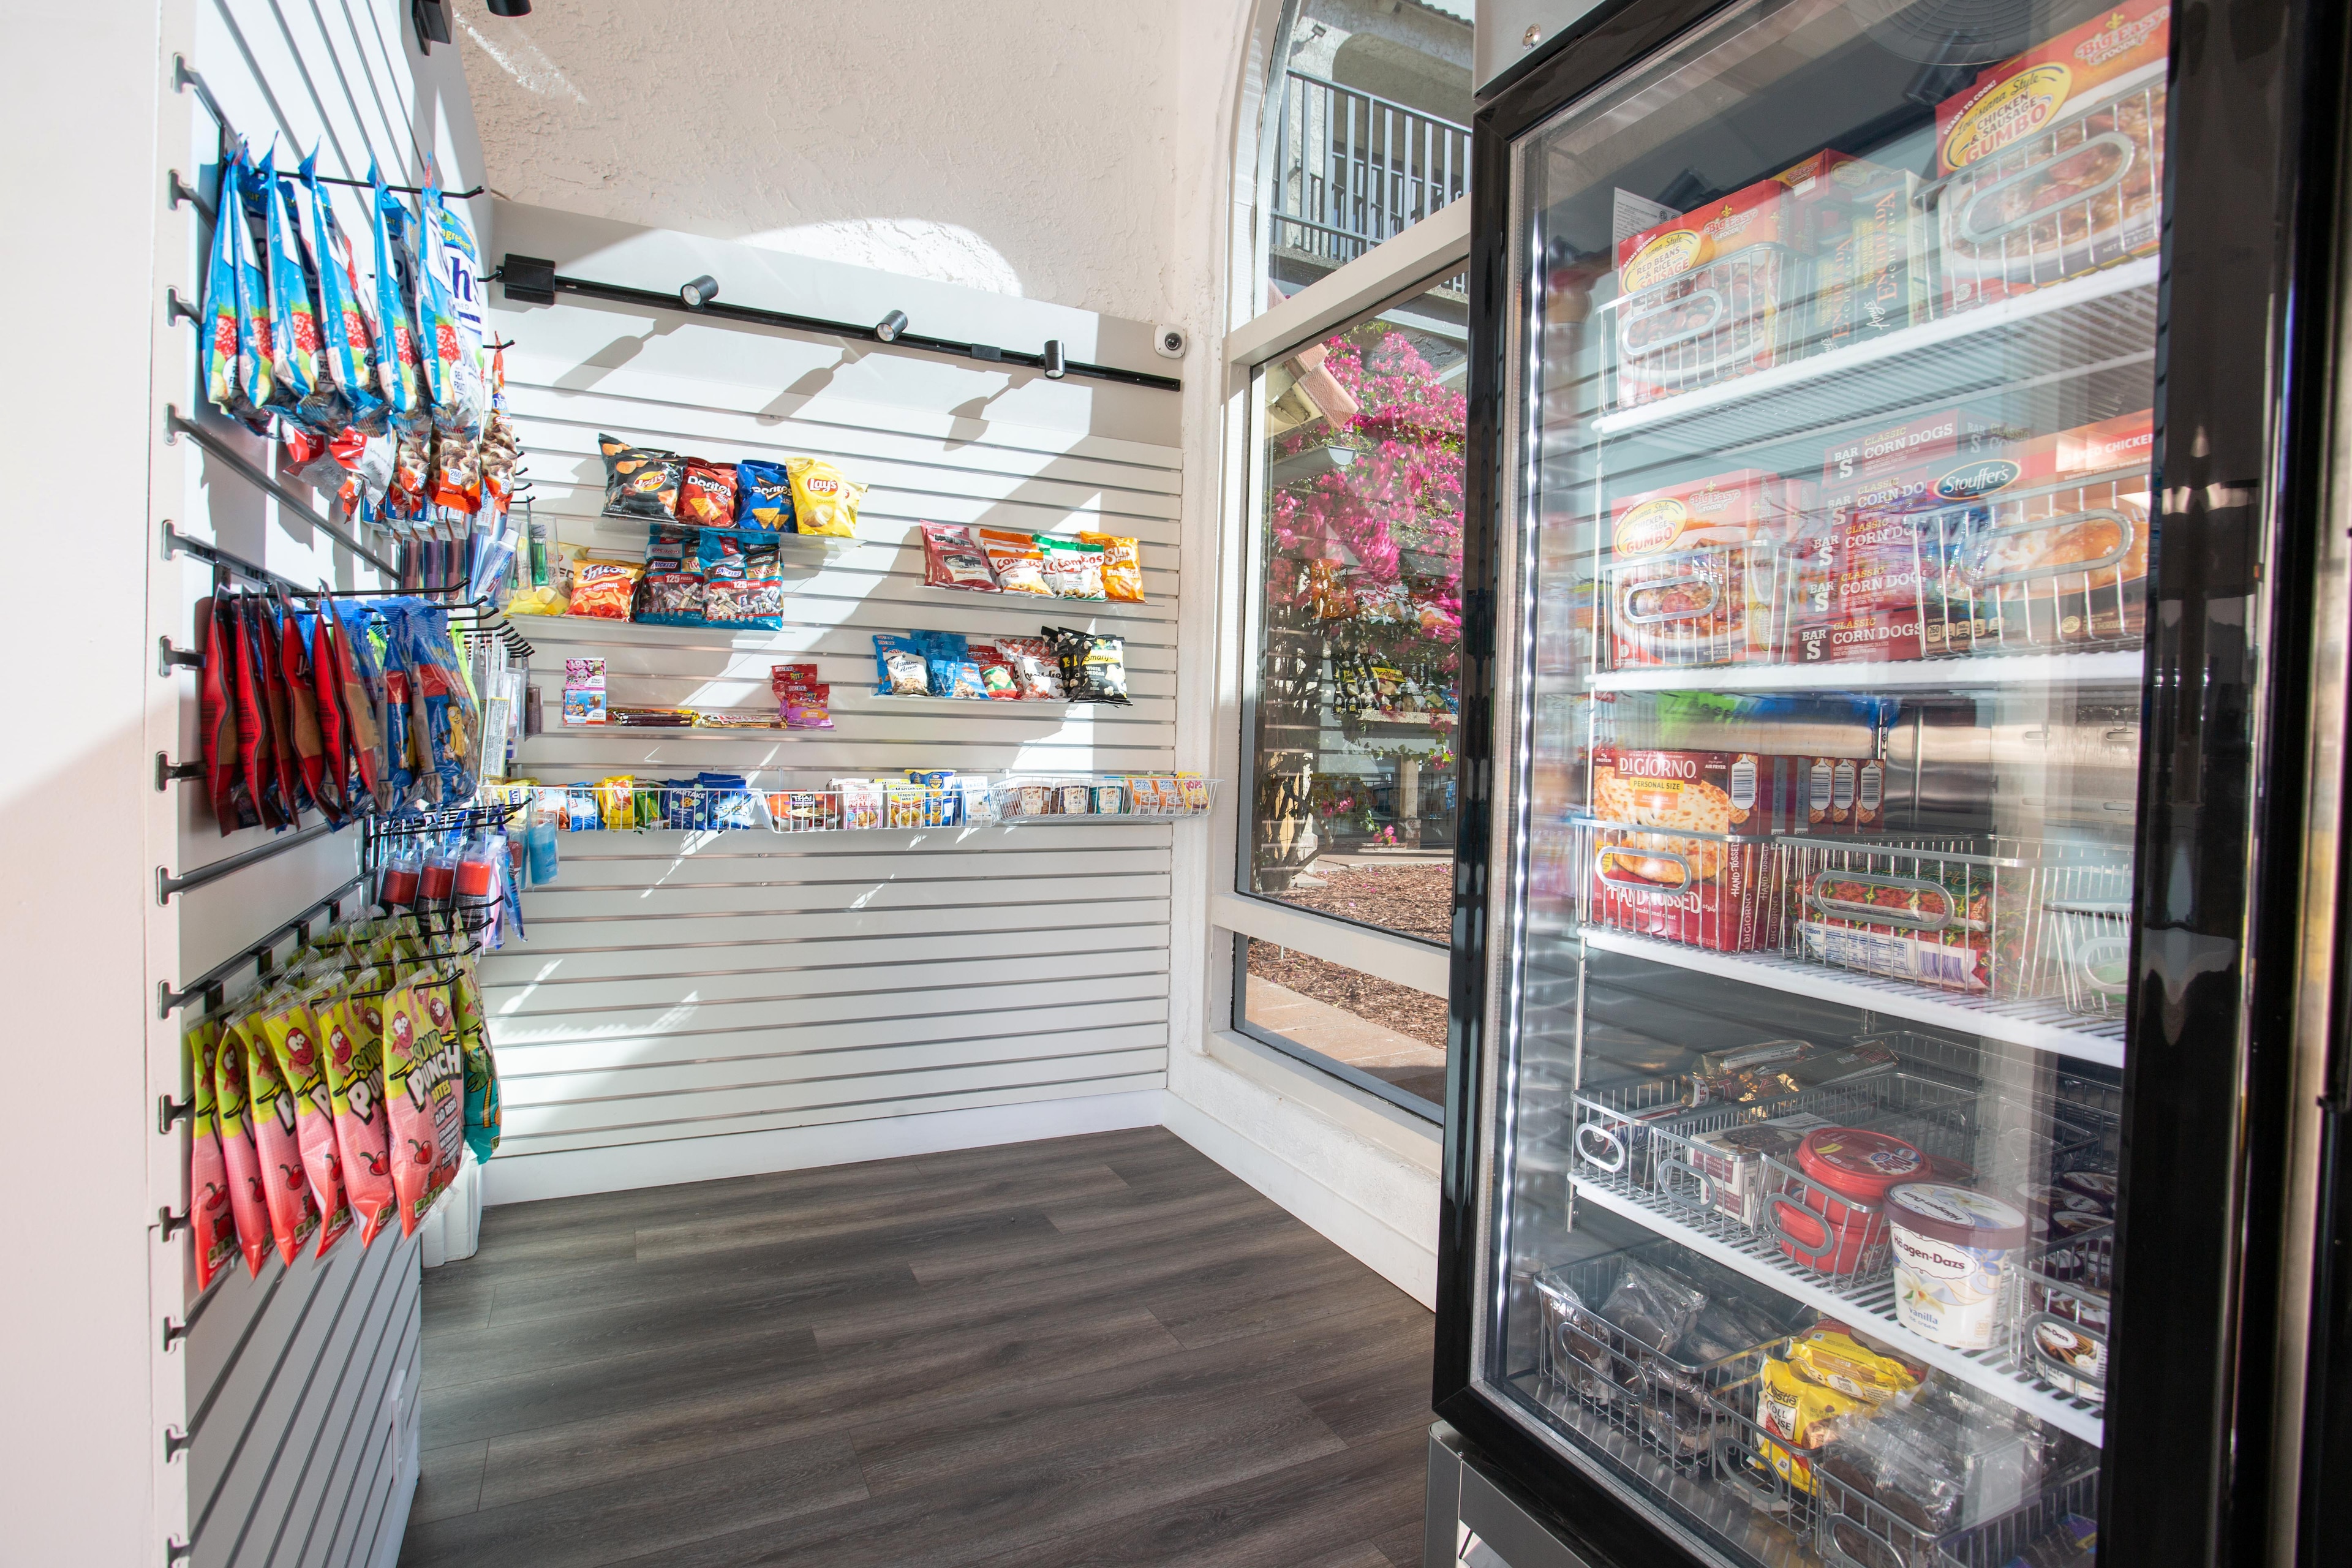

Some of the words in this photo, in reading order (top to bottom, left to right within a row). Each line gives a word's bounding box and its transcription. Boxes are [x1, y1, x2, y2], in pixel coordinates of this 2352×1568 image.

[2077, 34, 2112, 56] Big
[1943, 110, 1964, 135] READY
[1964, 100, 1973, 110] TO
[1973, 80, 1997, 100] COOK!
[1956, 92, 2007, 136] Louisiana
[2011, 73, 2039, 96] Style
[1977, 91, 2030, 130] CHICKEN
[1970, 134, 1979, 145] &
[1983, 96, 2037, 137] SAUSAGE
[1965, 103, 2046, 165] GUMBO
[1705, 220, 1726, 234] Big
[1728, 209, 1757, 227] Easy
[1666, 235, 1683, 247] Style
[1719, 227, 1740, 238] FOODS
[1623, 252, 1638, 269] READY
[1637, 245, 1643, 254] TO
[1642, 233, 1657, 247] COOK!
[1876, 189, 1897, 304] ENCHILADA
[1637, 262, 1653, 276] RED
[1654, 246, 1680, 266] BEANS
[1645, 270, 1651, 279] &
[1653, 259, 1671, 274] RICE
[1640, 258, 1689, 289] SAUSAGE
[1832, 235, 1853, 339] ENCHILADA
[1864, 300, 1890, 330] Amy's
[352, 433, 363, 447] 12
[1864, 437, 1906, 459] CORN
[1909, 423, 1953, 446] DOGS
[1865, 426, 1907, 446] CLASSIC
[1834, 447, 1858, 462] BAR
[450, 470, 461, 479] 260
[1839, 458, 1853, 479] S
[501, 480, 510, 488] 260
[638, 474, 665, 488] Lay's
[687, 475, 732, 497] Doritos
[810, 478, 838, 492] Lay's
[1858, 478, 1899, 495] CLASSIC
[1944, 465, 2009, 493] Stouffer's
[751, 486, 792, 497] Doritos
[1691, 492, 1710, 503] Big
[1711, 489, 1740, 502] Easy
[1857, 488, 1899, 508] CORN
[1902, 481, 1925, 497] DO
[1654, 502, 1670, 514] Style
[1702, 503, 1722, 512] FOODS
[1828, 495, 1851, 509] BAR
[1615, 512, 1627, 526] READY
[1634, 514, 1664, 530] CHICKEN
[1832, 507, 1847, 526] S
[1845, 518, 1889, 535] CLASSIC
[1626, 527, 1673, 554] GUMBO
[1814, 535, 1839, 549] BAR
[1845, 530, 1888, 549] CORN
[1819, 546, 1833, 567] S
[582, 564, 628, 581] Fritos
[665, 575, 680, 583] 125
[715, 567, 742, 577] SNICKERS
[1841, 567, 1885, 582] CLASSIC
[593, 582, 620, 590] ORIGINAL
[1810, 581, 1834, 594] BAR
[1840, 578, 1882, 595] CORN
[1815, 592, 1830, 612] S
[1833, 617, 1877, 630] CLASSIC
[1833, 628, 1875, 644] CORN
[1879, 622, 1921, 639] DOGS
[1802, 629, 1826, 641] BAR
[1807, 640, 1821, 660] S
[672, 789, 706, 799] PARTAKE
[1184, 780, 1203, 792] POPS
[1702, 904, 1716, 913] style
[413, 1029, 443, 1067] SOUR
[407, 1044, 461, 1107] PUNCH
[431, 1079, 452, 1105] BITES
[435, 1107, 446, 1126] RAD
[444, 1097, 458, 1115] REDS
[1904, 1191, 1962, 1221] Häagen-Dazs
[1893, 1232, 1966, 1270] Häagen-Dazs
[1909, 1306, 1939, 1325] vanilla
[1918, 1321, 1939, 1332] cream
[1766, 1381, 1799, 1406] Nestlé
